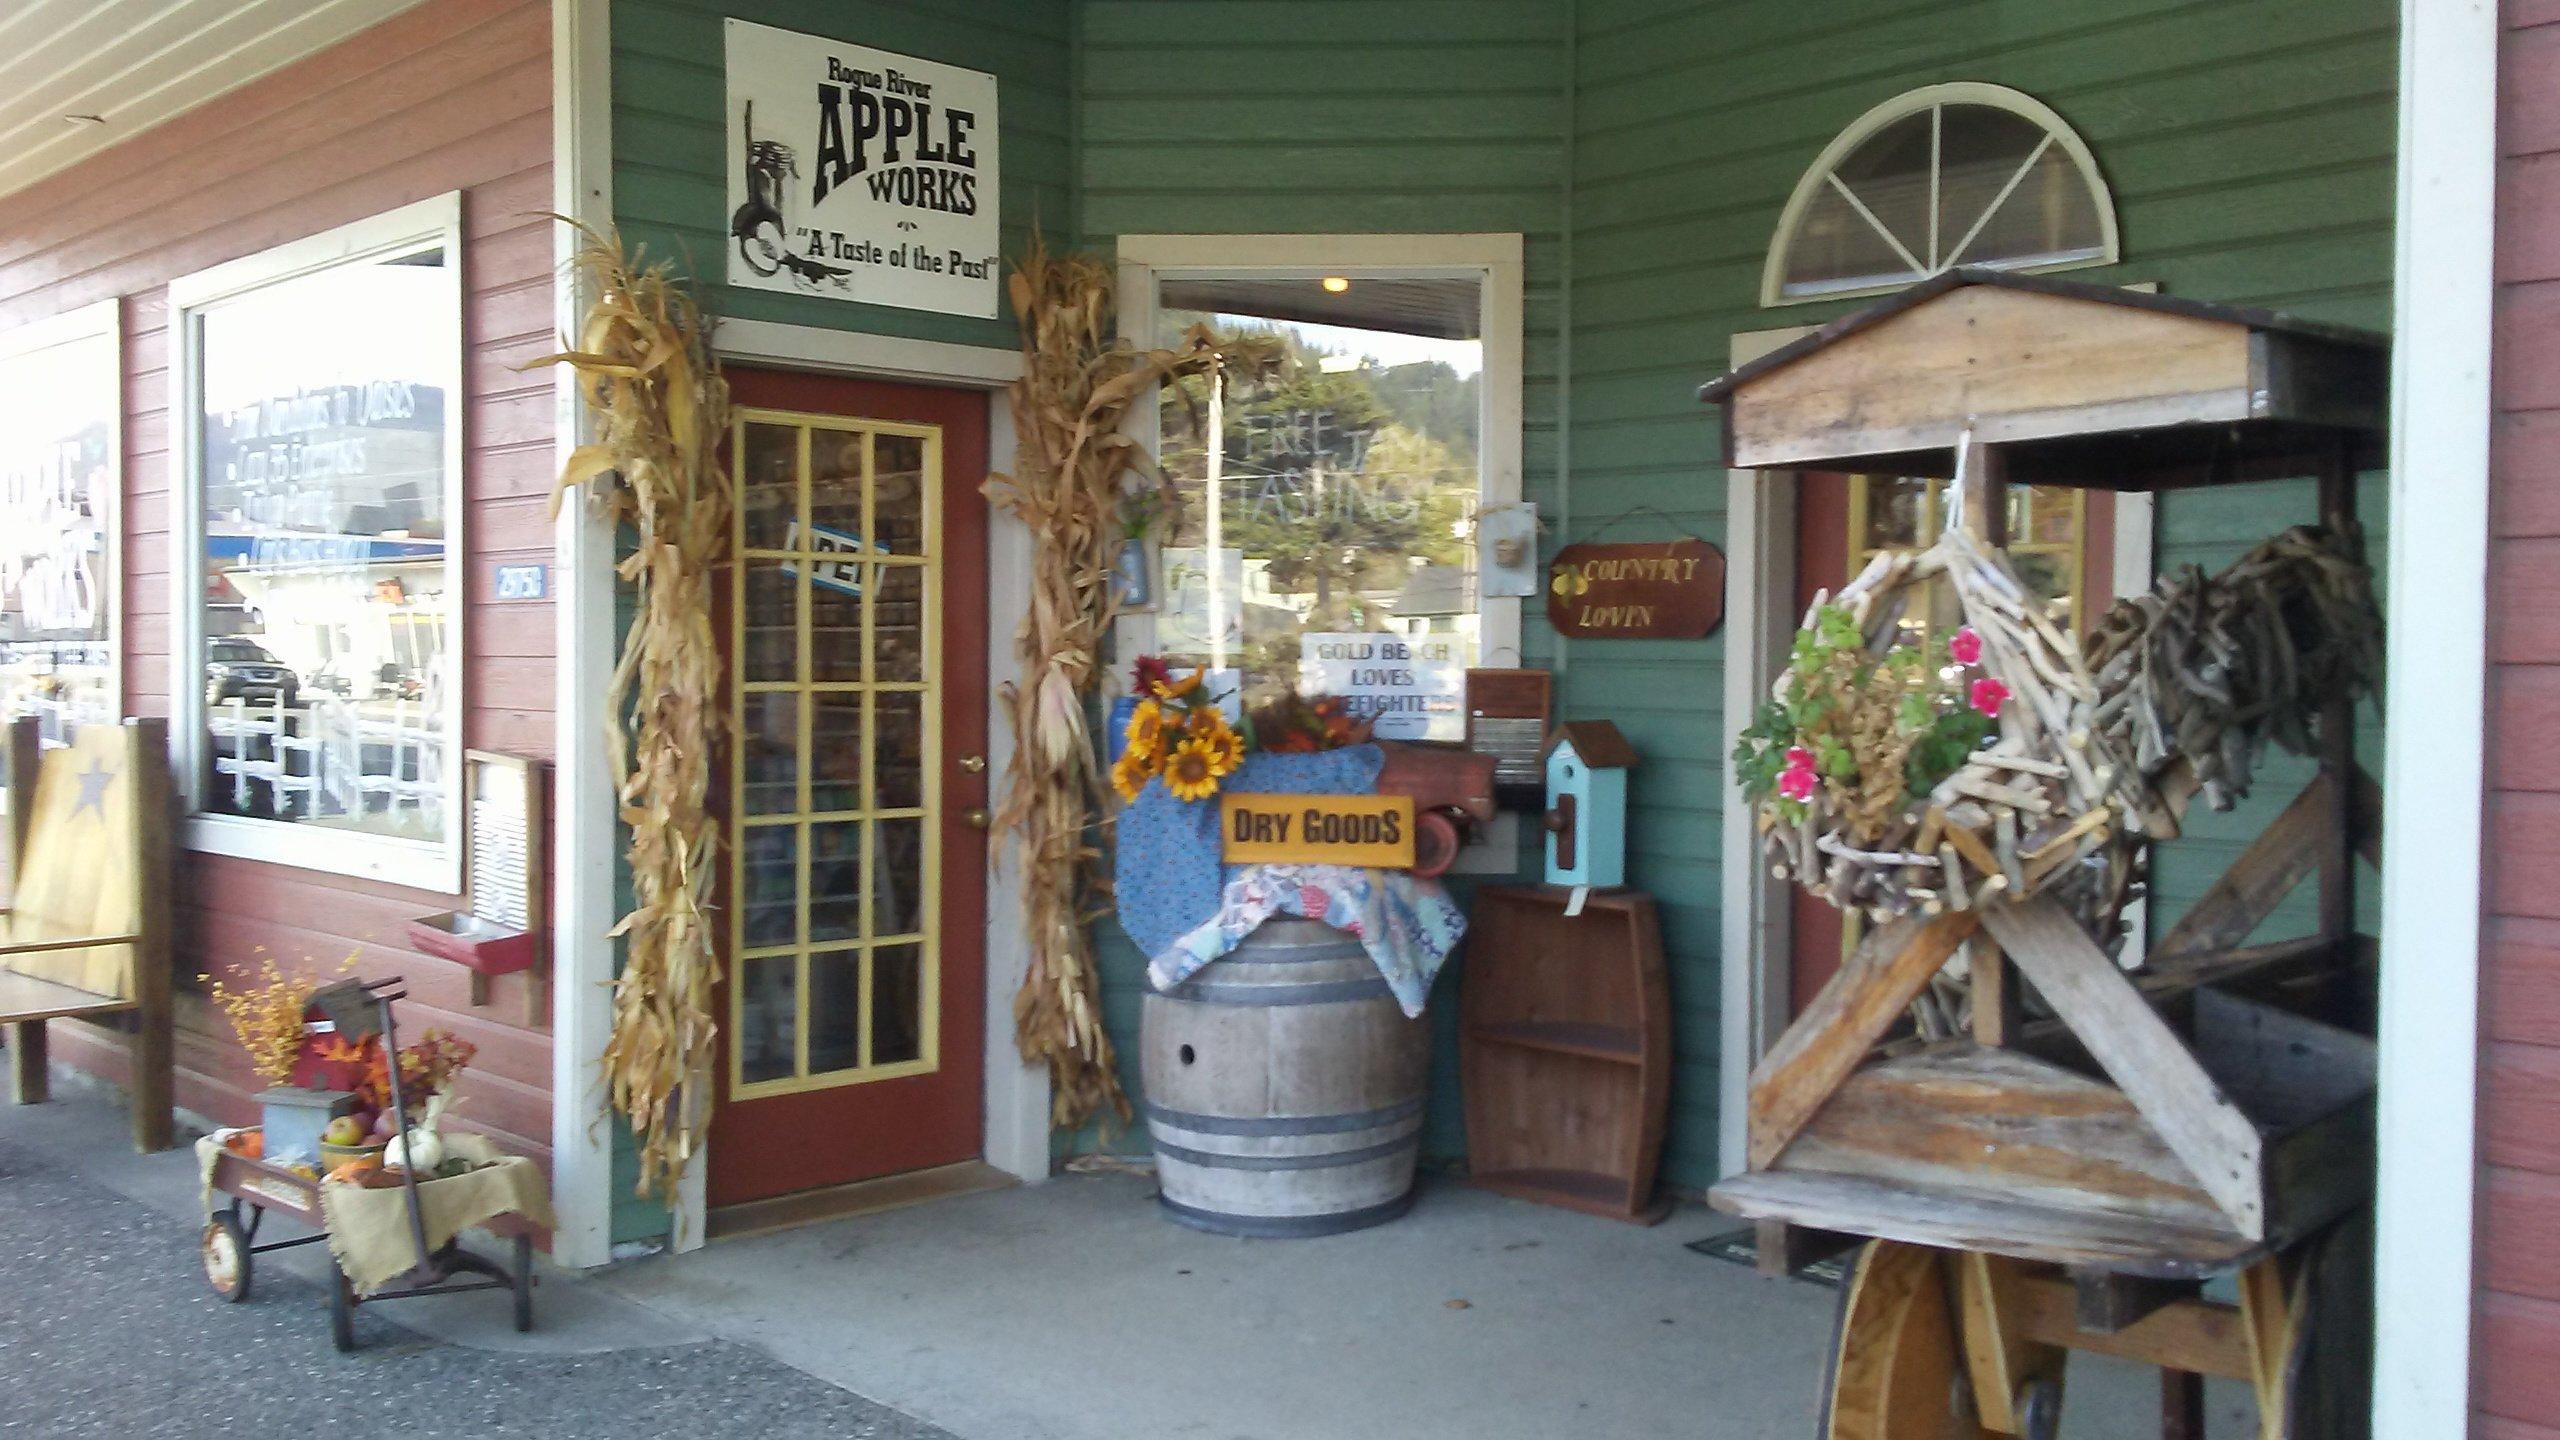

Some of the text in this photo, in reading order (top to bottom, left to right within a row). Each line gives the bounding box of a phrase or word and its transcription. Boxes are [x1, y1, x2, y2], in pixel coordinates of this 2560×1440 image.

[828, 56, 931, 100] Rogue River
[813, 84, 976, 207] APPLE
[866, 167, 977, 216] WORKS
[831, 233, 882, 264] Taste
[890, 243, 907, 269] of
[914, 246, 943, 273] the
[1583, 558, 1699, 584] COUNTRY
[1579, 604, 1653, 628] LOVIN
[1318, 643, 1450, 660] GOLD BECH
[1352, 669, 1416, 686] LOVES
[1234, 808, 1400, 844] DRY GOODS
